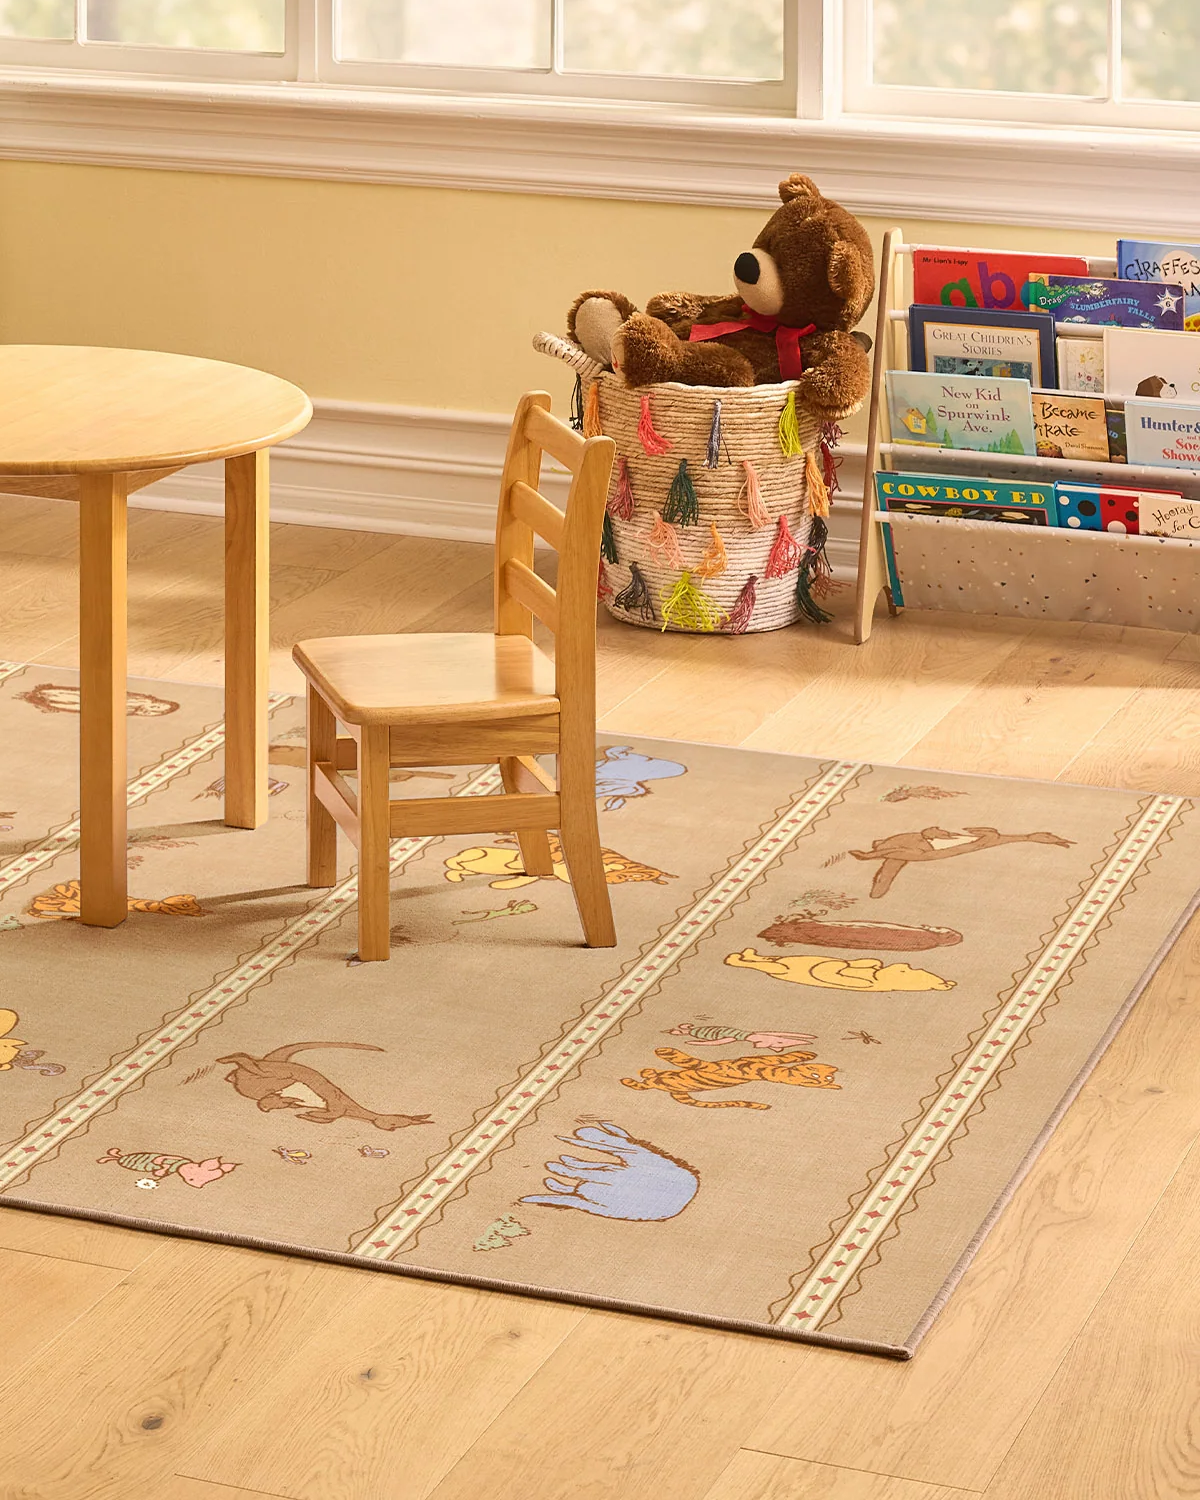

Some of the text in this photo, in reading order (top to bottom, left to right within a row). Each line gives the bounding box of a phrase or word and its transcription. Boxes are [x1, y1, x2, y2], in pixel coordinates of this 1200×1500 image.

[1124, 257, 1200, 282] GIRAFFES
[939, 261, 1029, 309] ab
[1038, 293, 1066, 306] Dragon
[1070, 297, 1140, 312] SLUMBERFAIRY
[1127, 306, 1156, 323] FALLS
[932, 328, 1032, 346] GREAT CHILDREN'S
[962, 343, 1003, 356] STORIES
[941, 386, 1003, 401] New Kid
[937, 405, 1012, 422] Spurwink
[966, 402, 980, 410] on
[962, 420, 993, 434] Ave.
[882, 482, 1046, 505] COWBOY ED
[1152, 504, 1194, 527] Hooray
[1172, 520, 1187, 534] for
